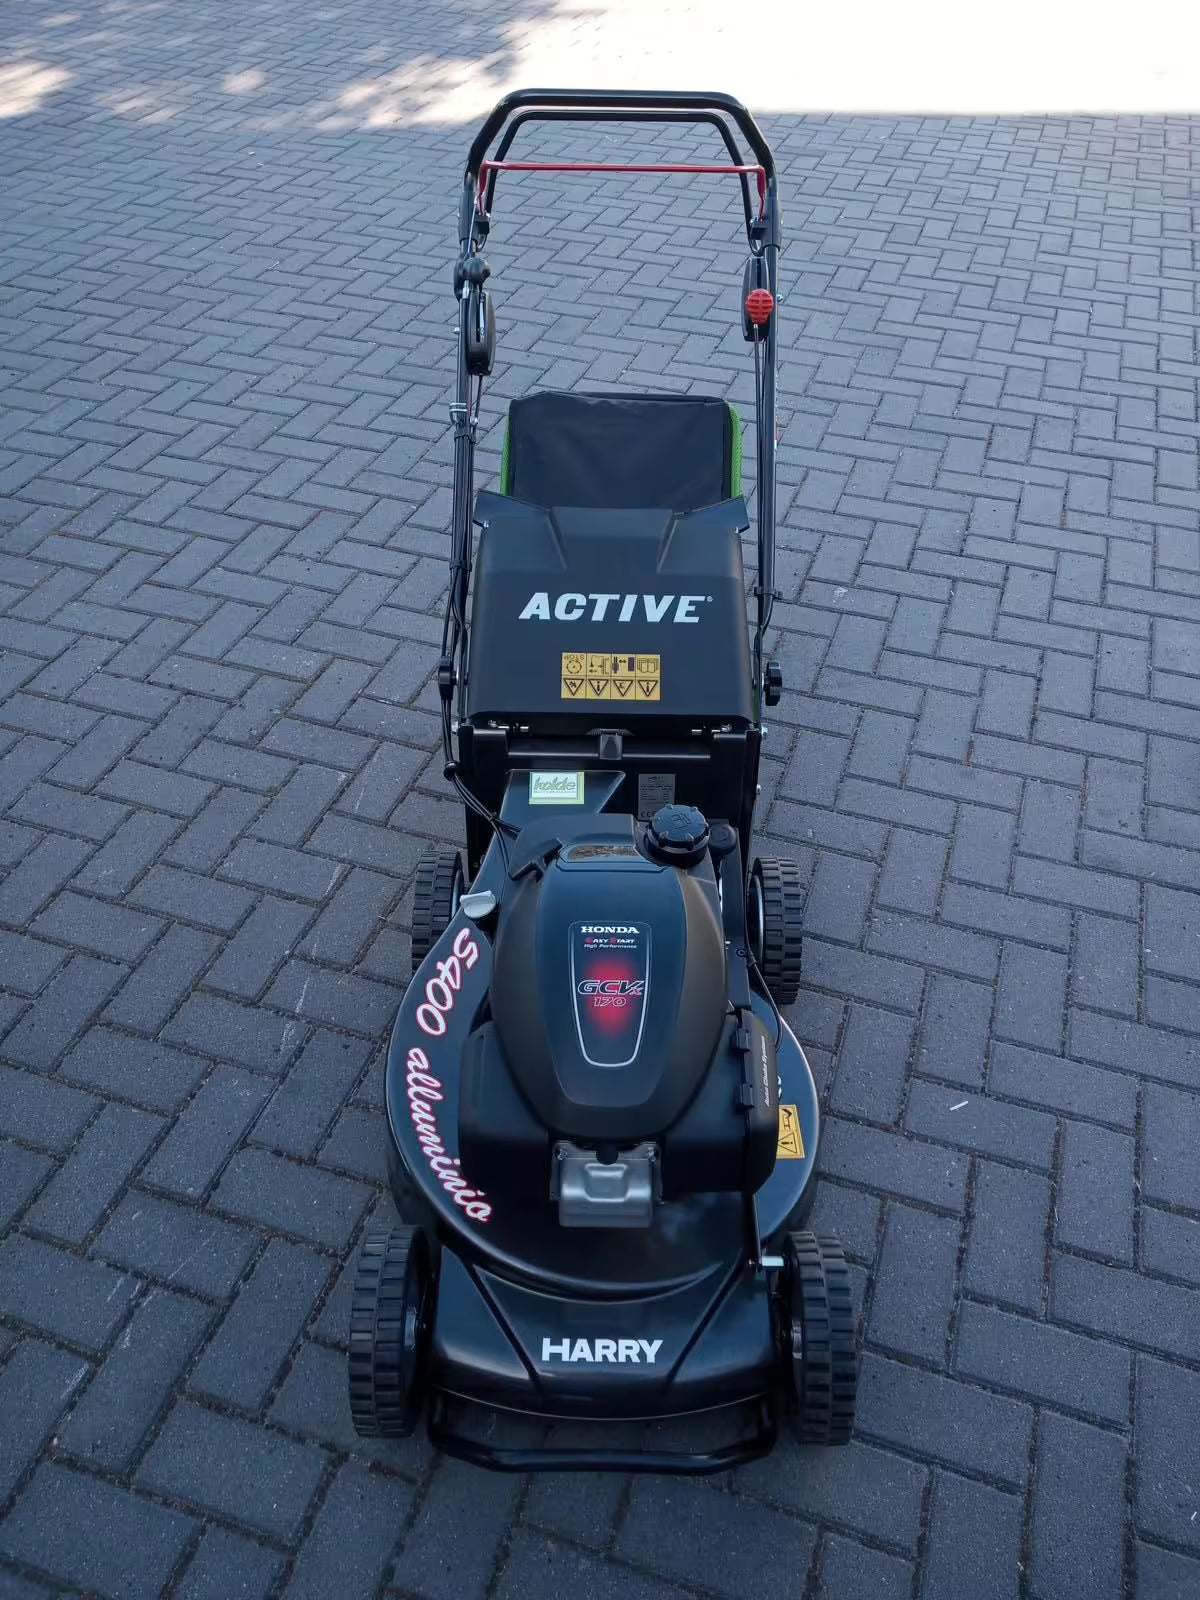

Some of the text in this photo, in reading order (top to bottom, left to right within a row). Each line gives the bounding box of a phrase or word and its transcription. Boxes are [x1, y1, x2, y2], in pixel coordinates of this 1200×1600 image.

[518, 592, 705, 623] ACTIVE
[581, 926, 640, 934] HONDA
[594, 997, 627, 1007] 170
[406, 1047, 492, 1222] alluminio
[541, 1337, 664, 1364] HARRY
